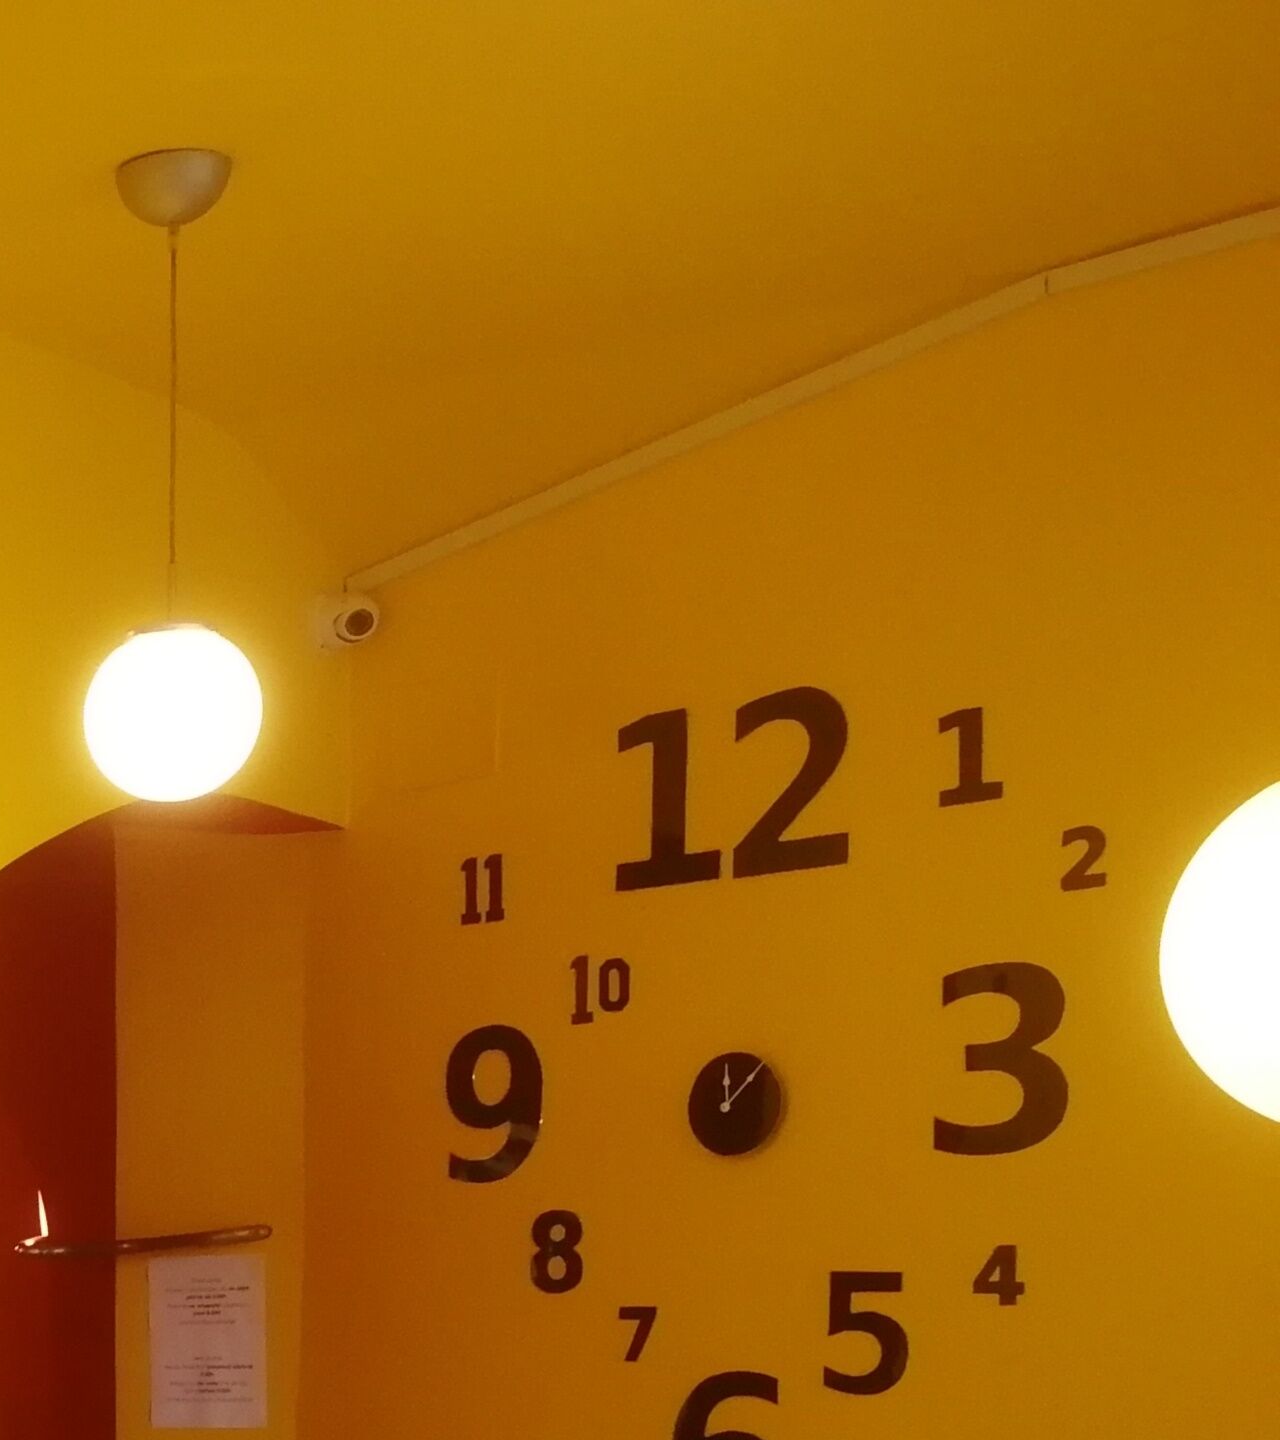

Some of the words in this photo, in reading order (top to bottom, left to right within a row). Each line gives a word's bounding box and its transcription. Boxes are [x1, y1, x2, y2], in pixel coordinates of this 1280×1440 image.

[614, 685, 849, 892] 12
[937, 707, 1004, 808] 1
[459, 853, 505, 925] 11
[1059, 825, 1107, 892] 2
[569, 955, 631, 1025] 10
[932, 961, 1069, 1157] 3
[444, 1023, 543, 1184] 9
[529, 1209, 584, 1294] 8
[972, 1244, 1025, 1306] 4
[616, 1306, 658, 1363] 7
[822, 1270, 909, 1396] 5
